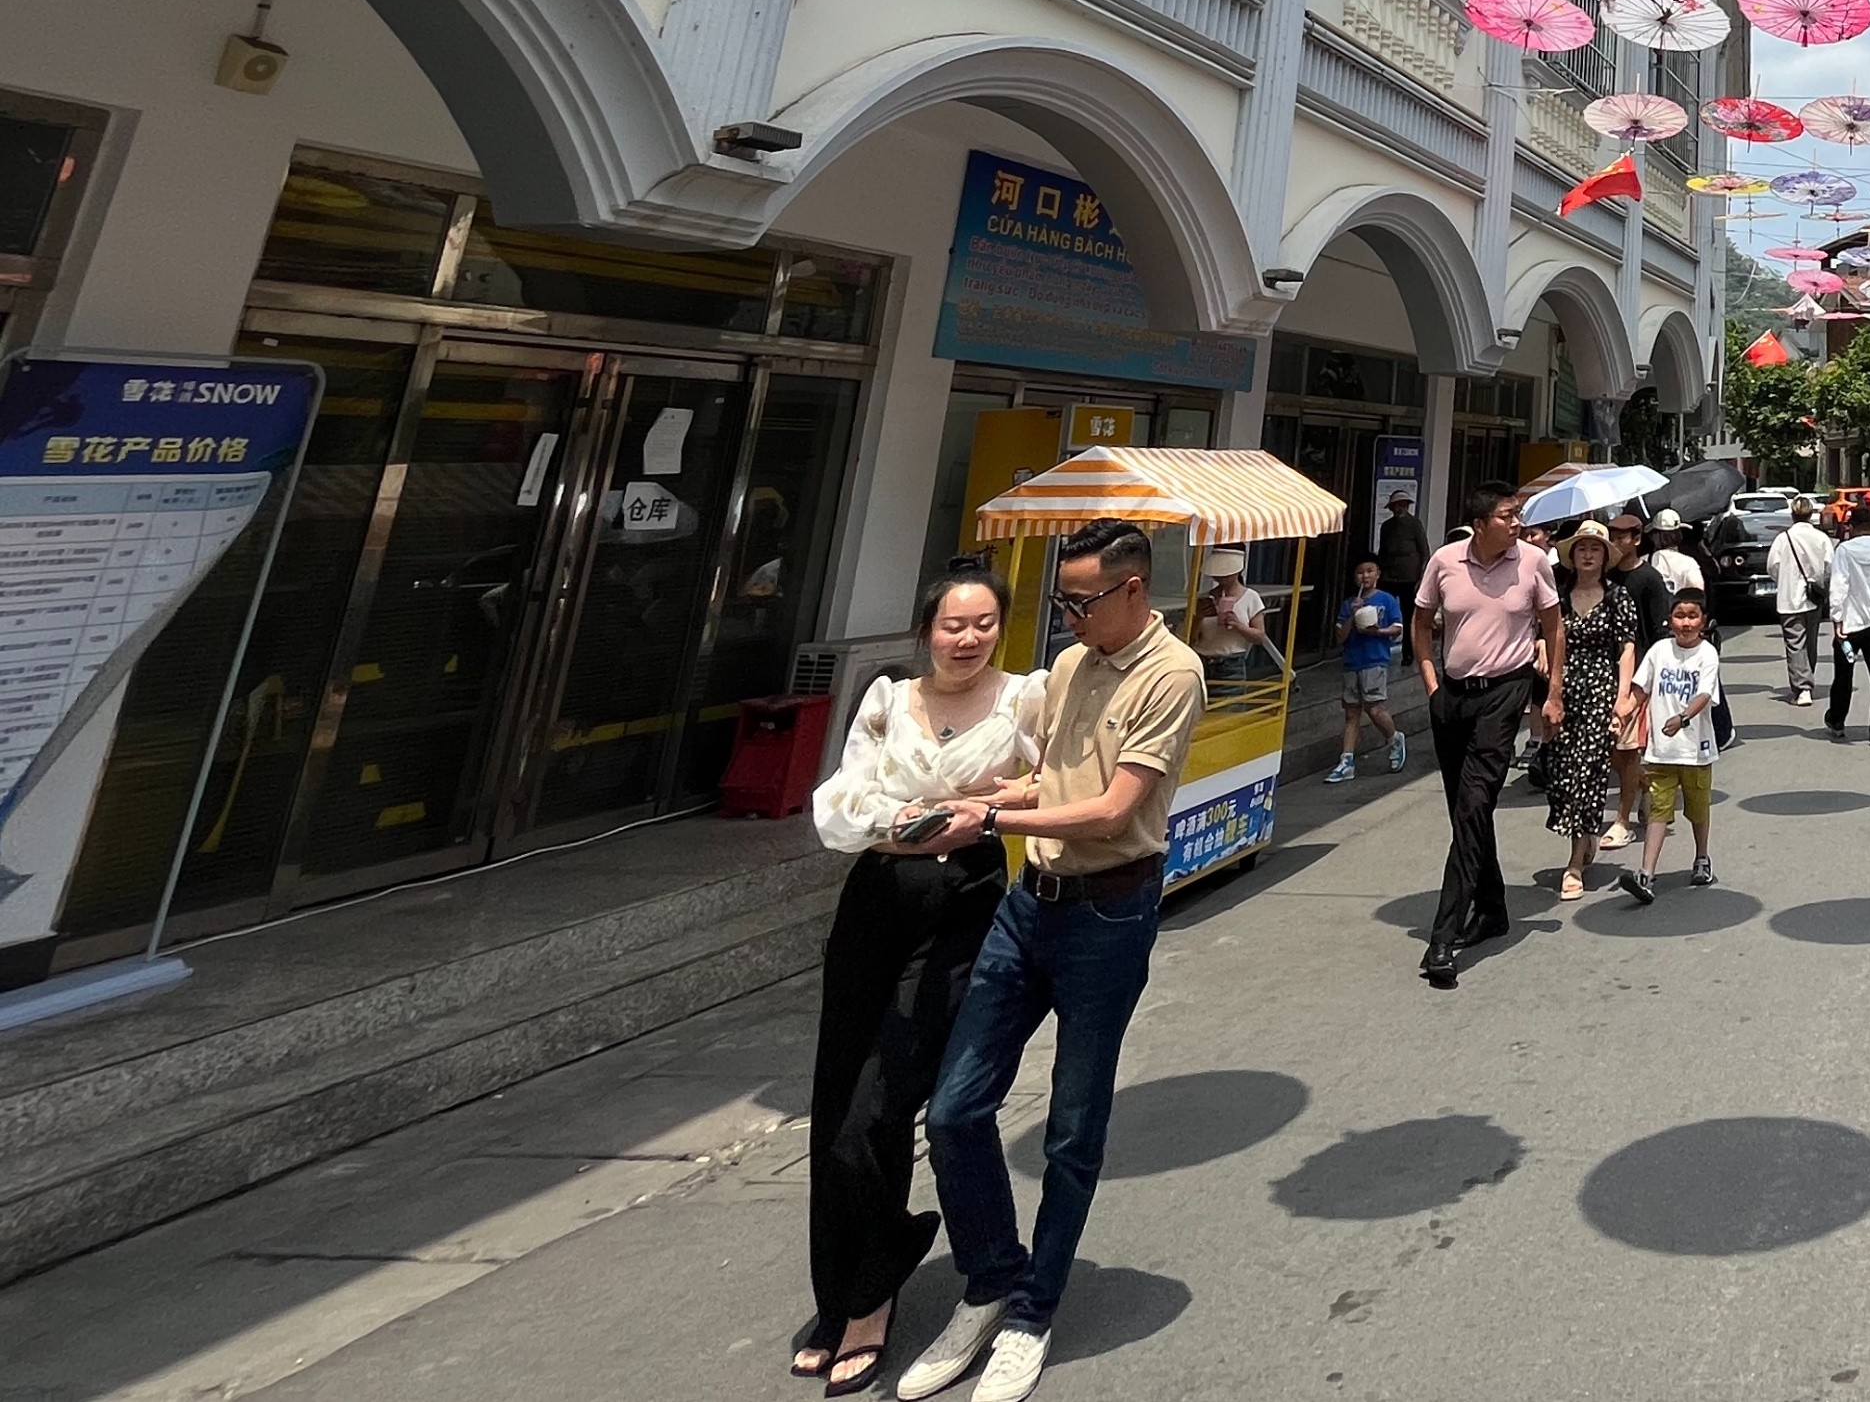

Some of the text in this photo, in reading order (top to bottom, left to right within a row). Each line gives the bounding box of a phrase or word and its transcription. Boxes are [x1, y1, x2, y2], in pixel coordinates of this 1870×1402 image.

[991, 170, 1122, 238] 河口彬
[122, 379, 177, 402] 雪花
[193, 382, 281, 405] SNOW
[42, 436, 249, 464] 雪花产品价格
[626, 497, 671, 522] 仓库
